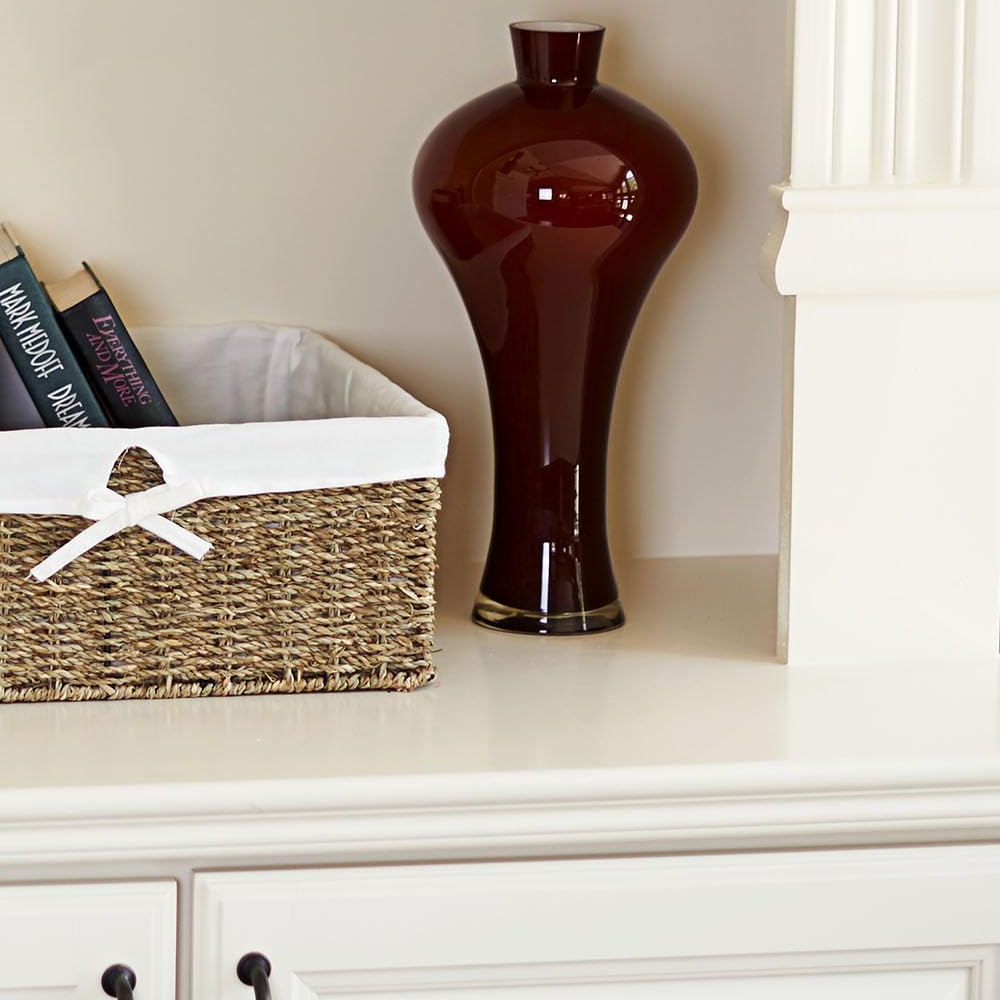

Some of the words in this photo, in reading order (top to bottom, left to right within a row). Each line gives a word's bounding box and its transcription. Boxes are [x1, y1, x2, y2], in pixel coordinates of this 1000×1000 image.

[16, 321, 64, 379] MEDOFF
[86, 333, 112, 362] AND
[92, 314, 152, 405] EVERYTHING
[96, 362, 136, 407] MORE
